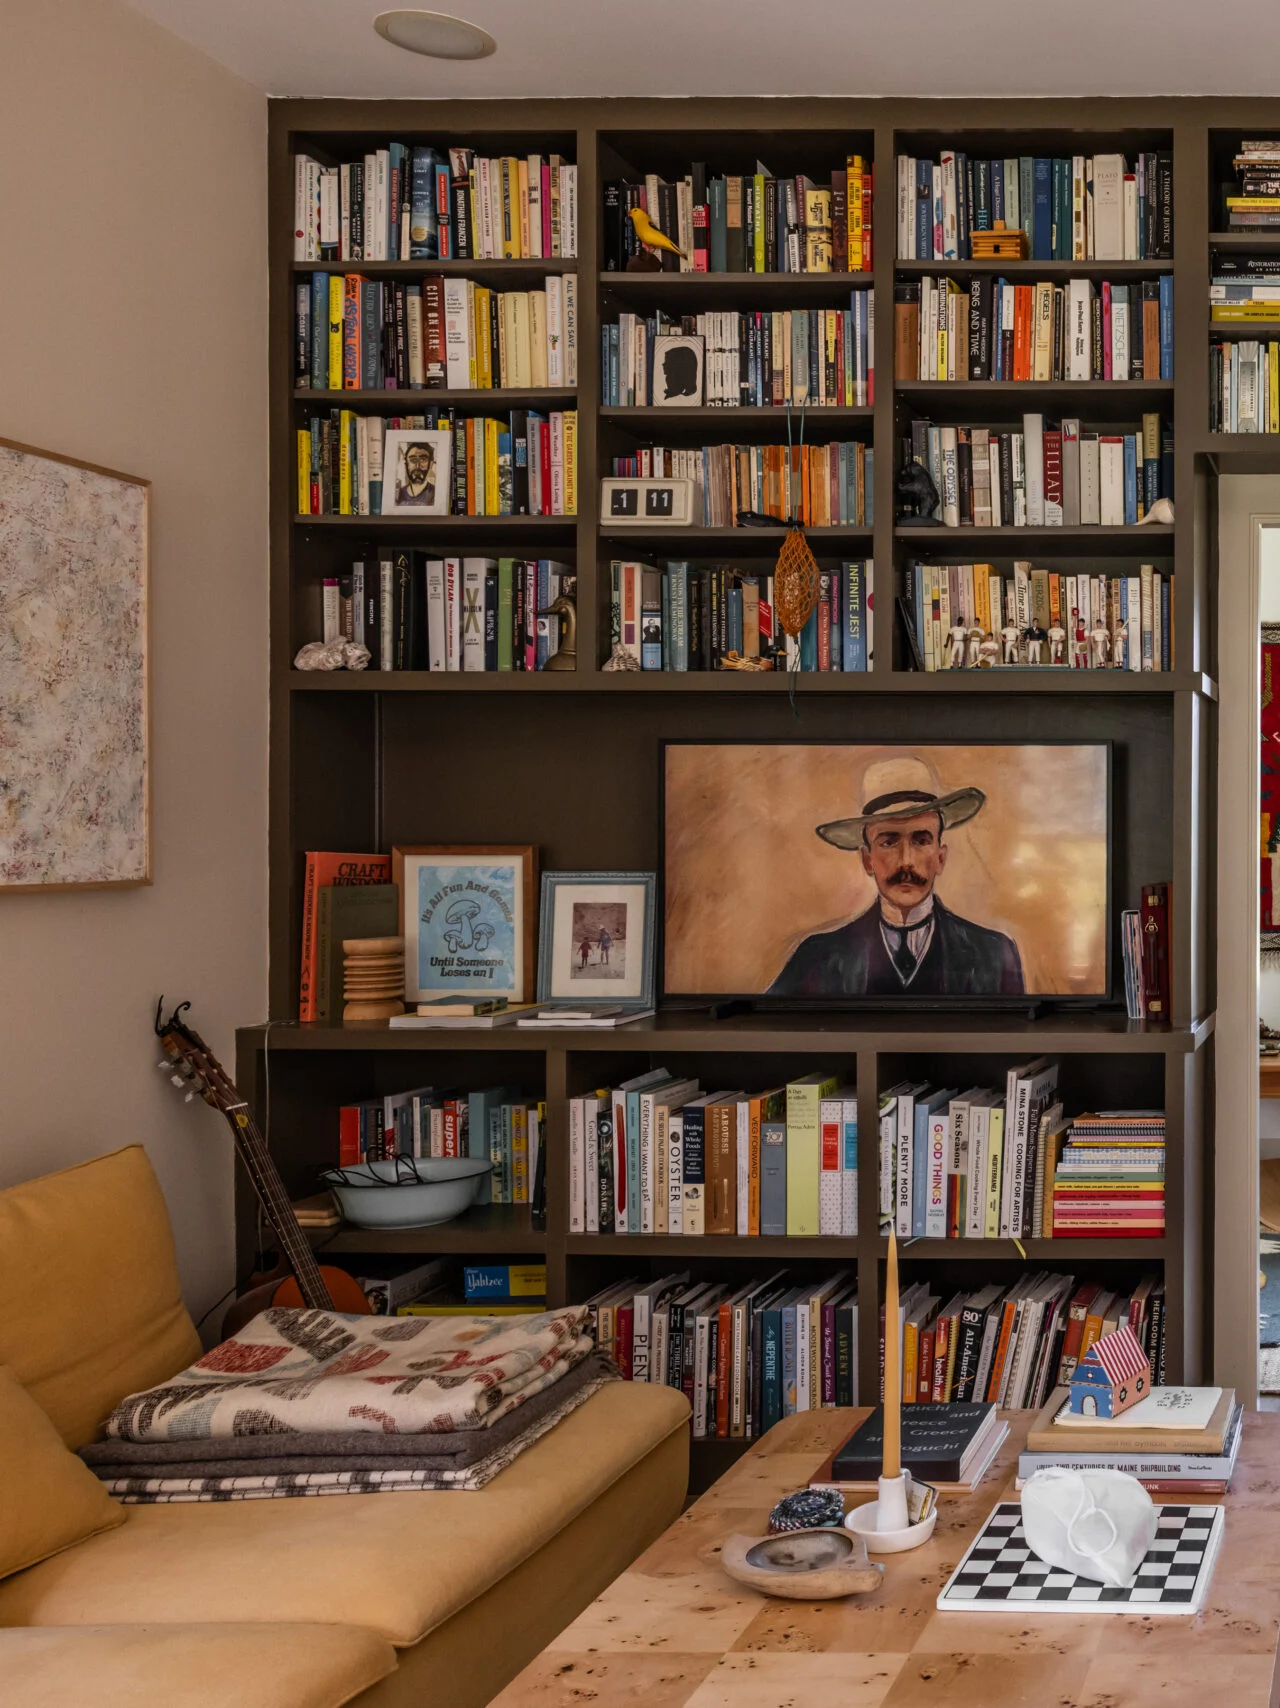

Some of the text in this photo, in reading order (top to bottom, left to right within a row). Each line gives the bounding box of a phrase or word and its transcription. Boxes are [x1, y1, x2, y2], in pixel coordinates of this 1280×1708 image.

[456, 190, 466, 247] JONATHAN FRANZEN
[1163, 205, 1170, 215] OF
[566, 280, 574, 294] ALL
[567, 296, 574, 309] WE
[345, 298, 358, 342] ASTRAL
[426, 285, 440, 350] CITY ON FIRE
[970, 281, 980, 356] BEING AND TIME
[1115, 307, 1125, 361] NIETZSCHE
[567, 329, 575, 349] SAVE
[946, 448, 956, 507] THE ODYSSEY
[1046, 451, 1060, 504] ILIAD
[650, 491, 669, 507] 11
[849, 564, 859, 639] INFINITE JEST
[1035, 578, 1044, 612] HERZOG
[1018, 585, 1028, 651] Time and Aain
[338, 862, 387, 877] CRAFT
[428, 891, 443, 909] All
[442, 883, 464, 897] Fun
[465, 880, 489, 893] And
[430, 957, 504, 967] Until Someone
[440, 967, 471, 977] Loses
[473, 969, 487, 977] an
[588, 1120, 596, 1142] Good
[641, 1100, 650, 1148] EVERYTHING
[721, 1108, 729, 1154] LAROUSSE
[953, 1113, 963, 1169] Six Seasons
[1017, 1110, 1025, 1137] STONE
[1026, 1108, 1038, 1173] Full Moon Suppers
[514, 1108, 522, 1200] INTERMEZZO SALLY ROONEY
[588, 1150, 596, 1172] Sweet
[657, 1112, 665, 1185] THE SILVER PALATE COOKBOOK
[932, 1124, 943, 1205] GOOD THINGS
[1015, 1143, 1023, 1180] COOKING
[641, 1176, 647, 1188] TO
[670, 1146, 681, 1202] OYSTER
[900, 1135, 908, 1207] PLENTY MORE
[990, 1154, 999, 1193] MEDITERRANEA
[600, 1178, 608, 1213] DONABE
[642, 1188, 650, 1202] EAT
[1012, 1199, 1020, 1232] ARTISTS
[1150, 1300, 1160, 1347] HEIRLOOM
[765, 1340, 776, 1381] NEPENTHE
[839, 1332, 848, 1377] ADVENT
[956, 1328, 975, 1399] All-American
[934, 1358, 945, 1400] health nut
[900, 1404, 951, 1413] oguchi
[949, 1410, 981, 1418] and
[900, 1442, 960, 1452] oguchi
[910, 1428, 969, 1436] Greece
[1117, 1464, 1181, 1472] MAINE SHIPBUILDING
